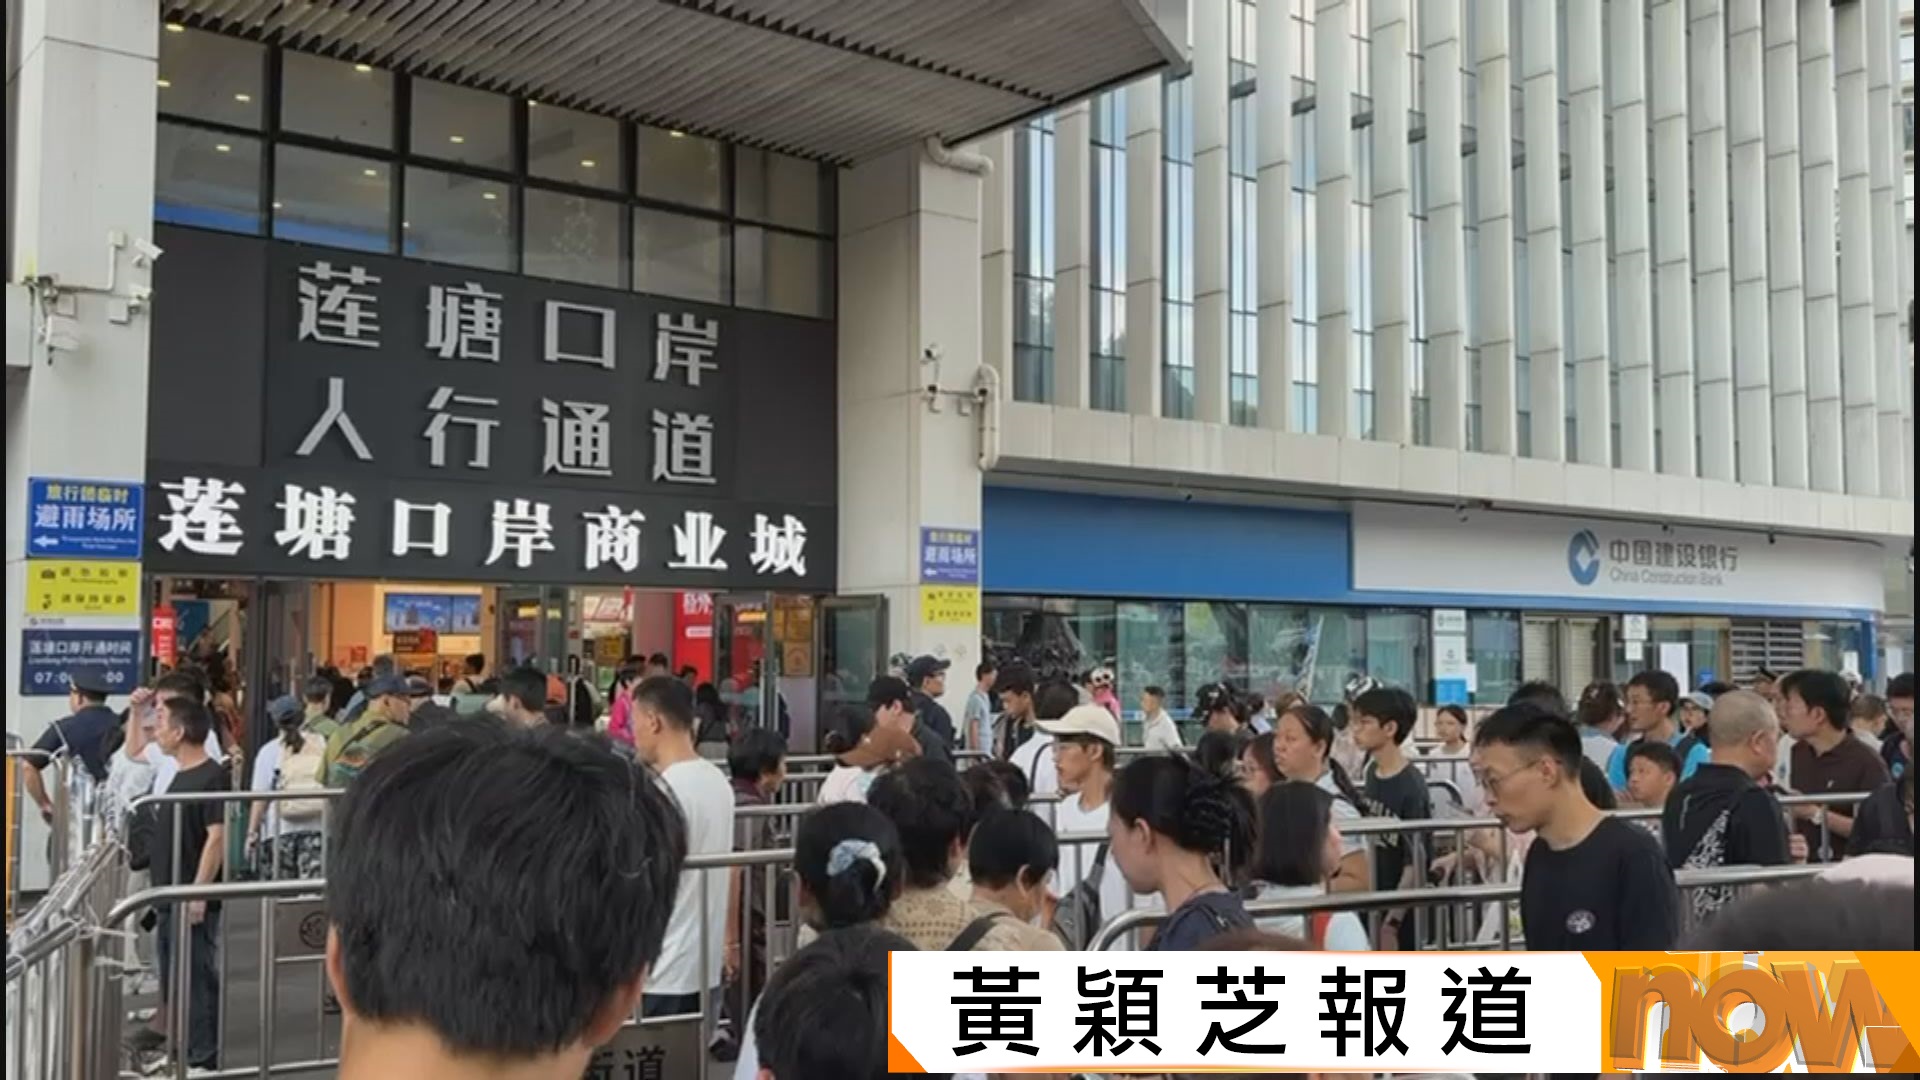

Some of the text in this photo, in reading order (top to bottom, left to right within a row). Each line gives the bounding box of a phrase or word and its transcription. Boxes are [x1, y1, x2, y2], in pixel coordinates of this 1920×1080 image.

[299, 261, 718, 386] 莲塘口岸
[296, 378, 717, 484] 人行通道
[158, 477, 808, 577] 莲塘口岸商业城
[1609, 538, 1738, 572] 中国建设银行
[34, 671, 69, 684] 07:0
